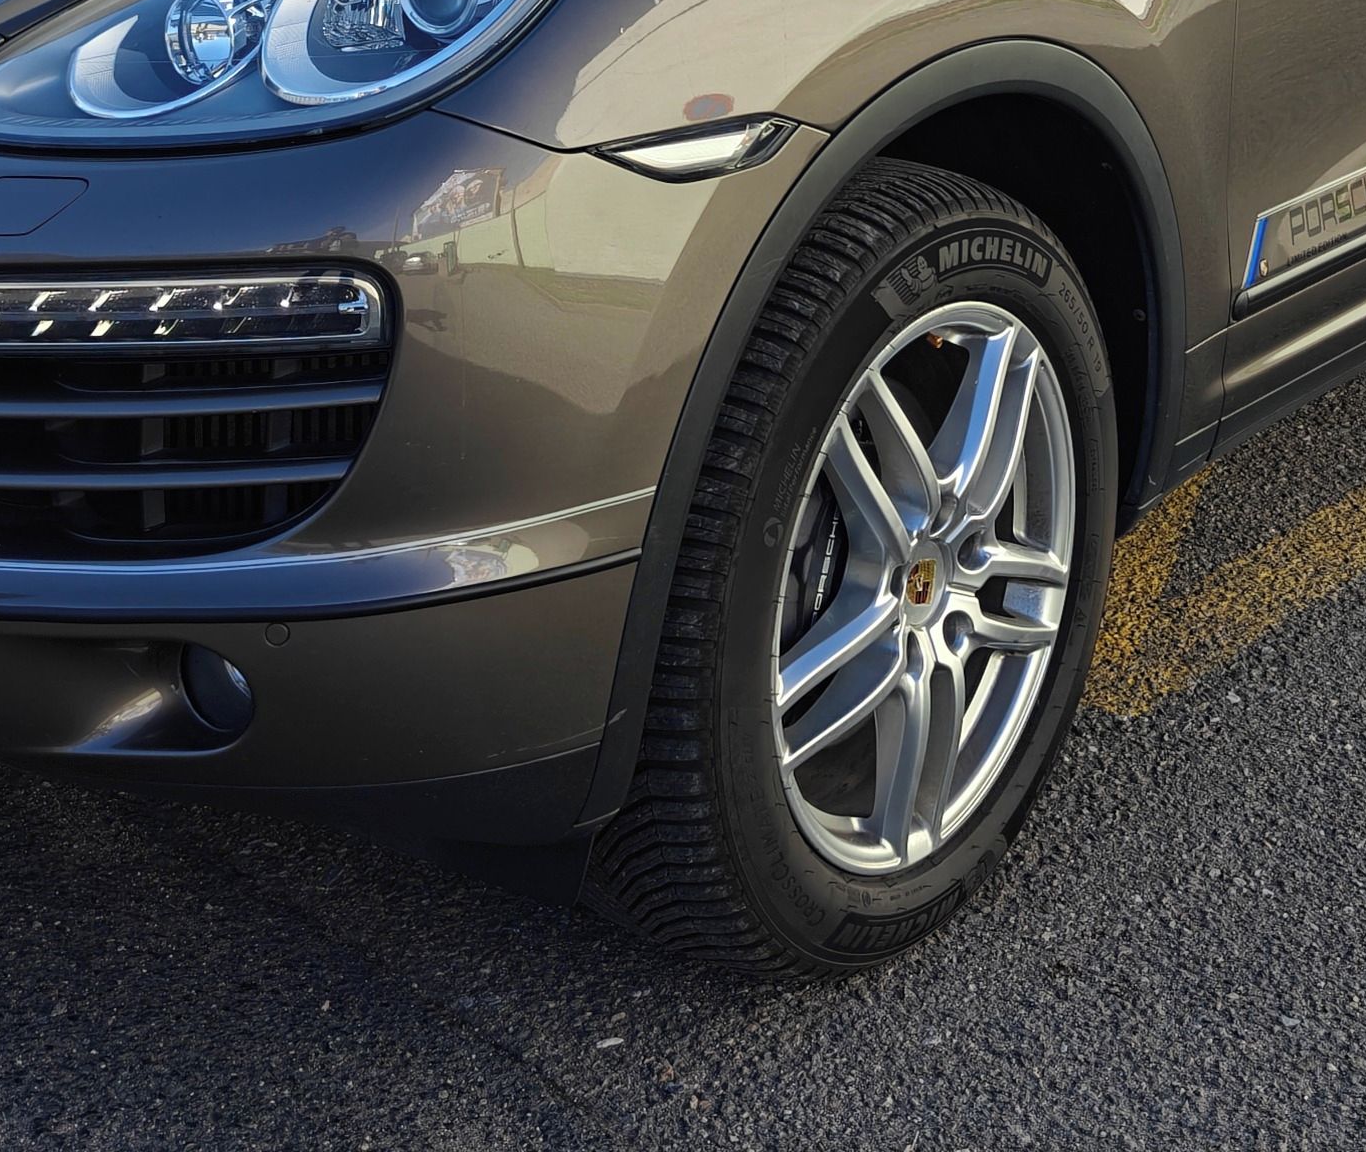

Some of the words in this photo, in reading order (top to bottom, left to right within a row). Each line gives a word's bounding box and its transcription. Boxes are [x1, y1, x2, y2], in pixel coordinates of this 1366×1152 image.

[938, 235, 1049, 279] MICHELIN
[1058, 282, 1089, 335] 265/50
[835, 887, 963, 949] MICHELIN
